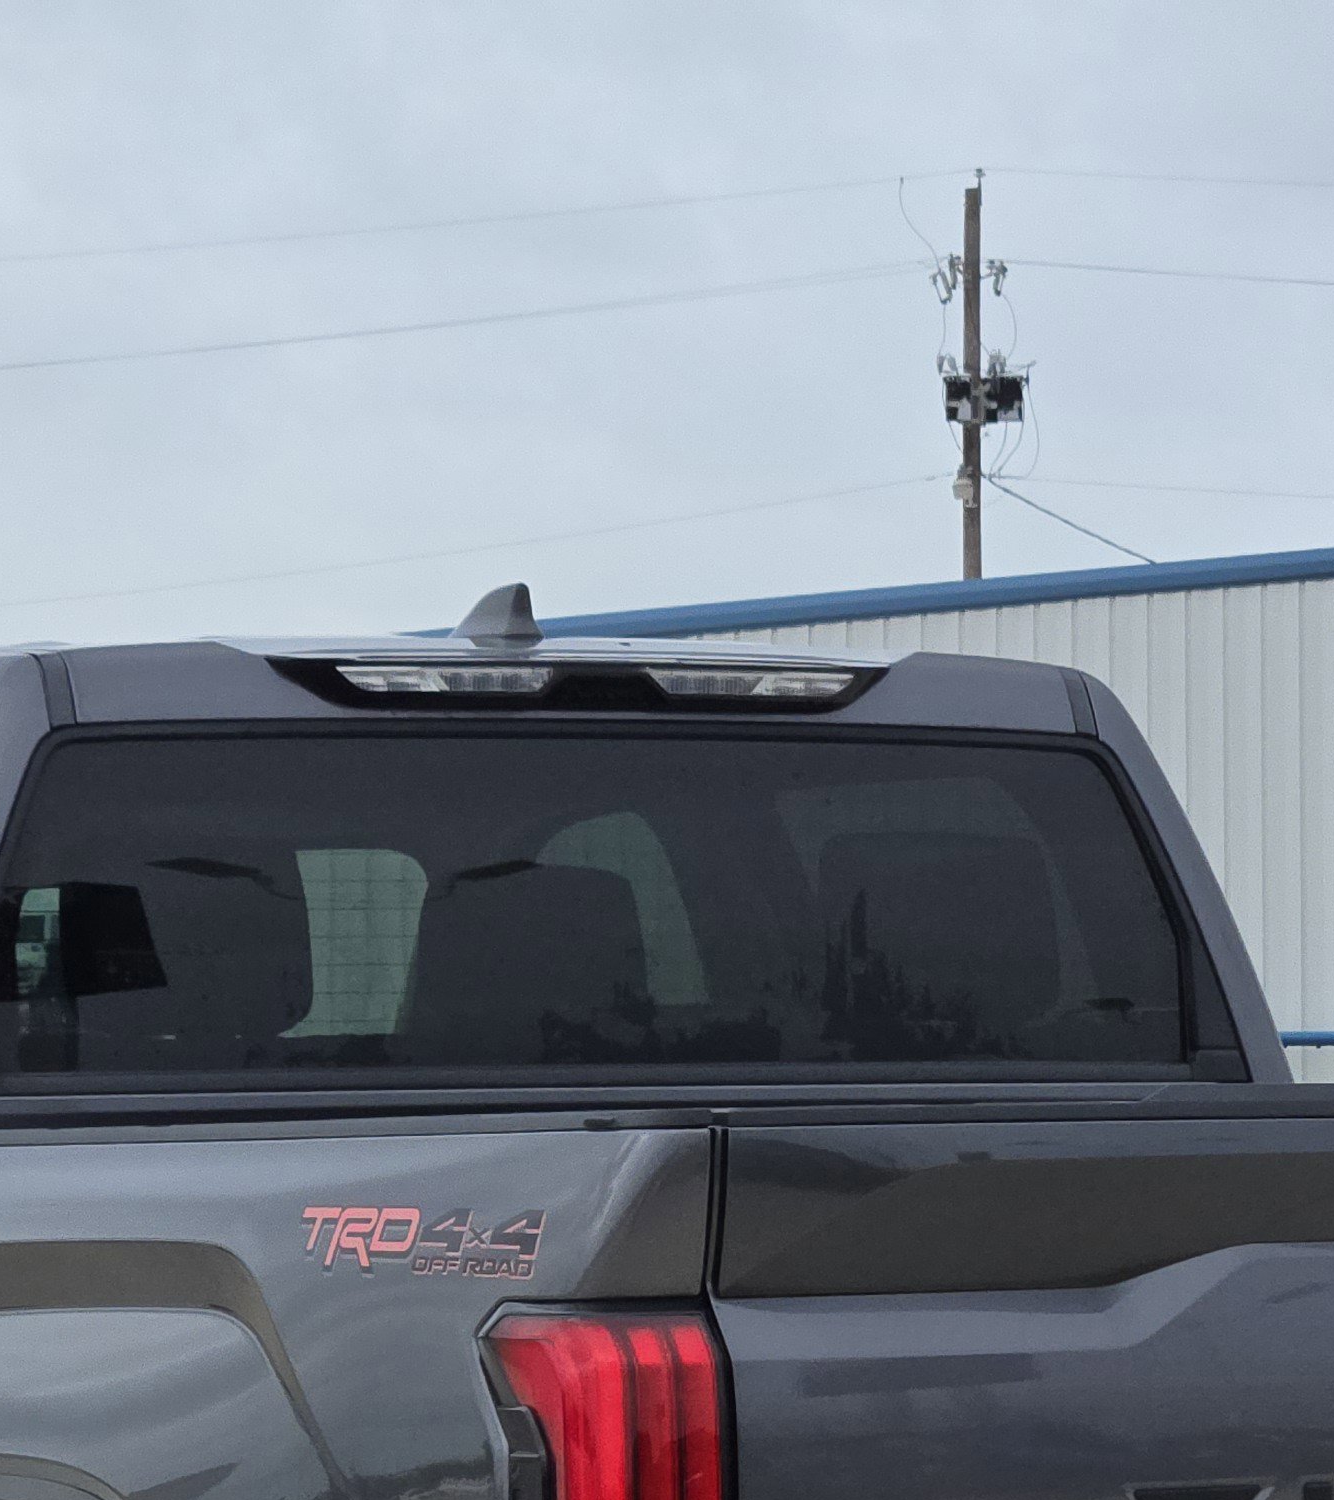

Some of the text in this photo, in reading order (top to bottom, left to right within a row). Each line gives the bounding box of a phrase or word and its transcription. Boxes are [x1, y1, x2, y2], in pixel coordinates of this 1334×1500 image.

[301, 1205, 546, 1276] TRD 4x4
[411, 1256, 535, 1280] OFF ROAD
